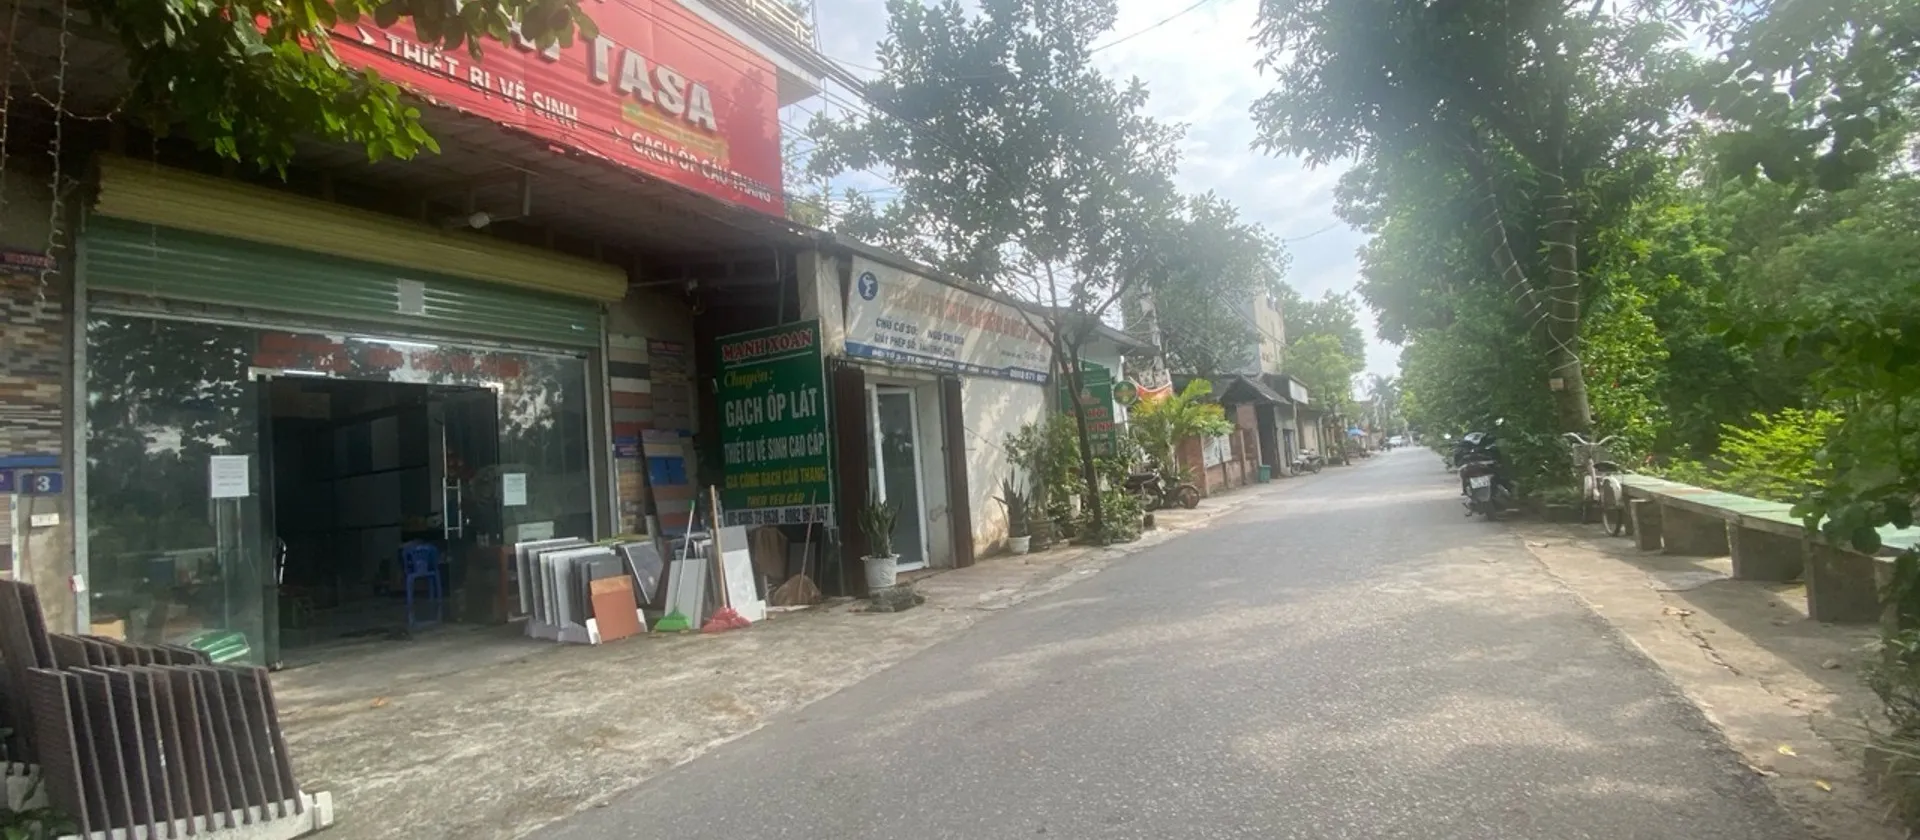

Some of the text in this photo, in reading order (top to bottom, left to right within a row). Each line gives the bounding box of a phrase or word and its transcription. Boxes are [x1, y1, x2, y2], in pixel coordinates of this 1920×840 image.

[385, 32, 578, 128] THIẾT BỊ VỆ SINH
[587, 34, 719, 131] TASA
[631, 131, 675, 166] GẠCH
[722, 329, 813, 364] MẠNH XOAN
[724, 369, 774, 389] Chuyên:
[725, 384, 818, 431] GẠCH ỐP LÁT
[724, 427, 824, 466] THIẾT BỊ VỆ SINH CAO CẤP
[37, 475, 50, 491] 3
